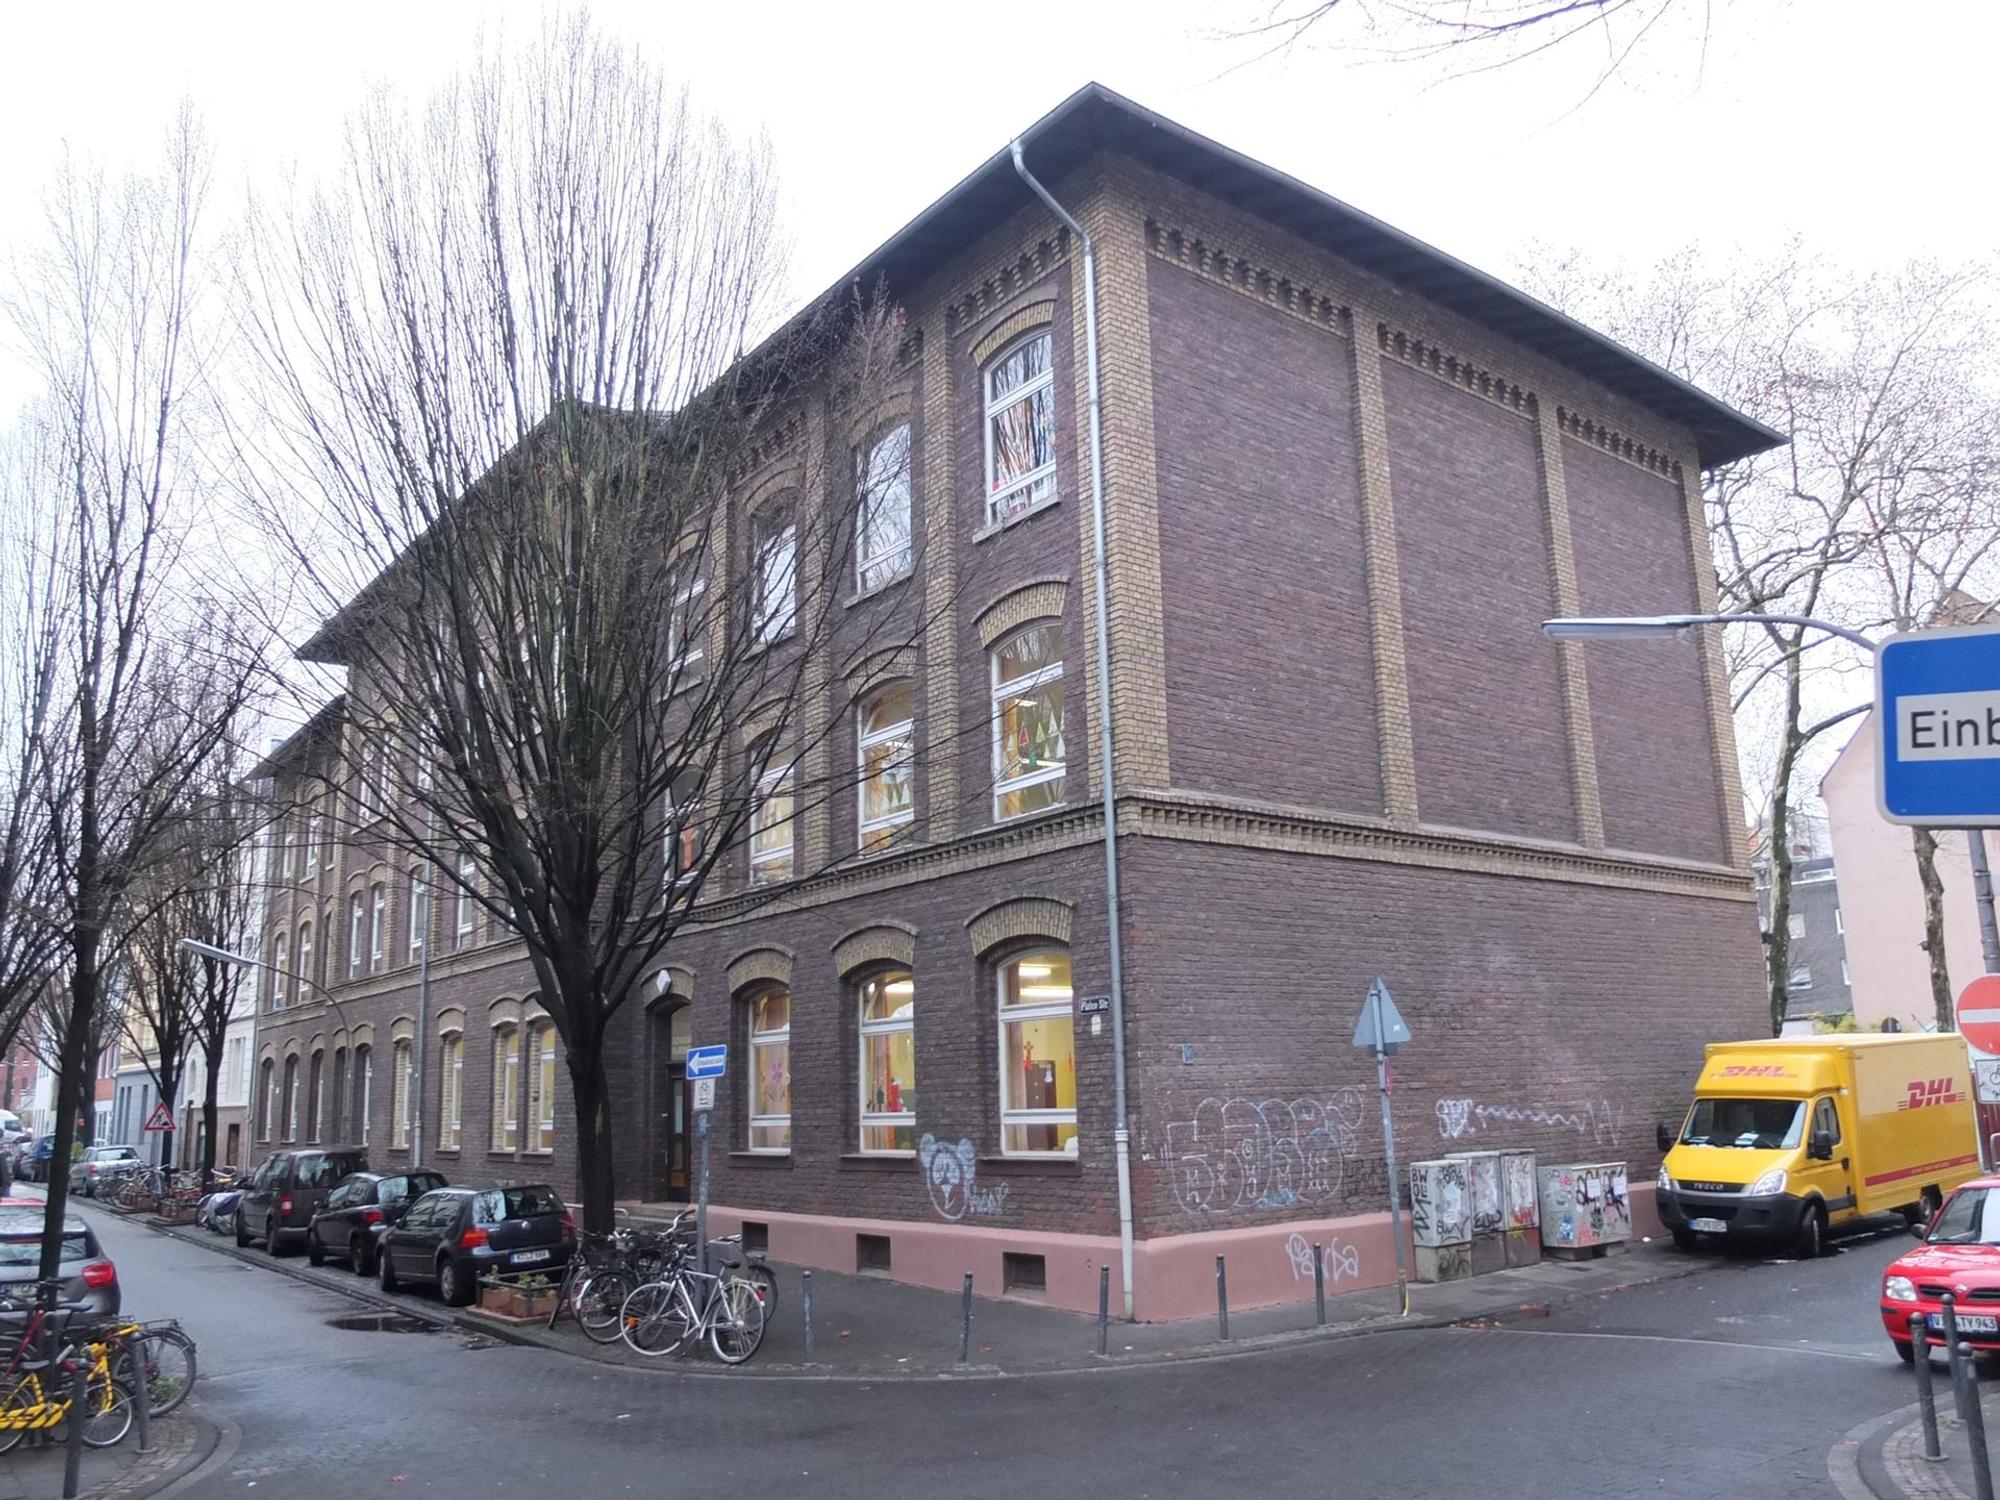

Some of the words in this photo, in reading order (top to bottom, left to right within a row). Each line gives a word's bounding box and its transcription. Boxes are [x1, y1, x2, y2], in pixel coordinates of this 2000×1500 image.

[1725, 1065, 1784, 1077] DHL
[1907, 1077, 1957, 1109] DHL
[1694, 1182, 1724, 1191] IVECO
